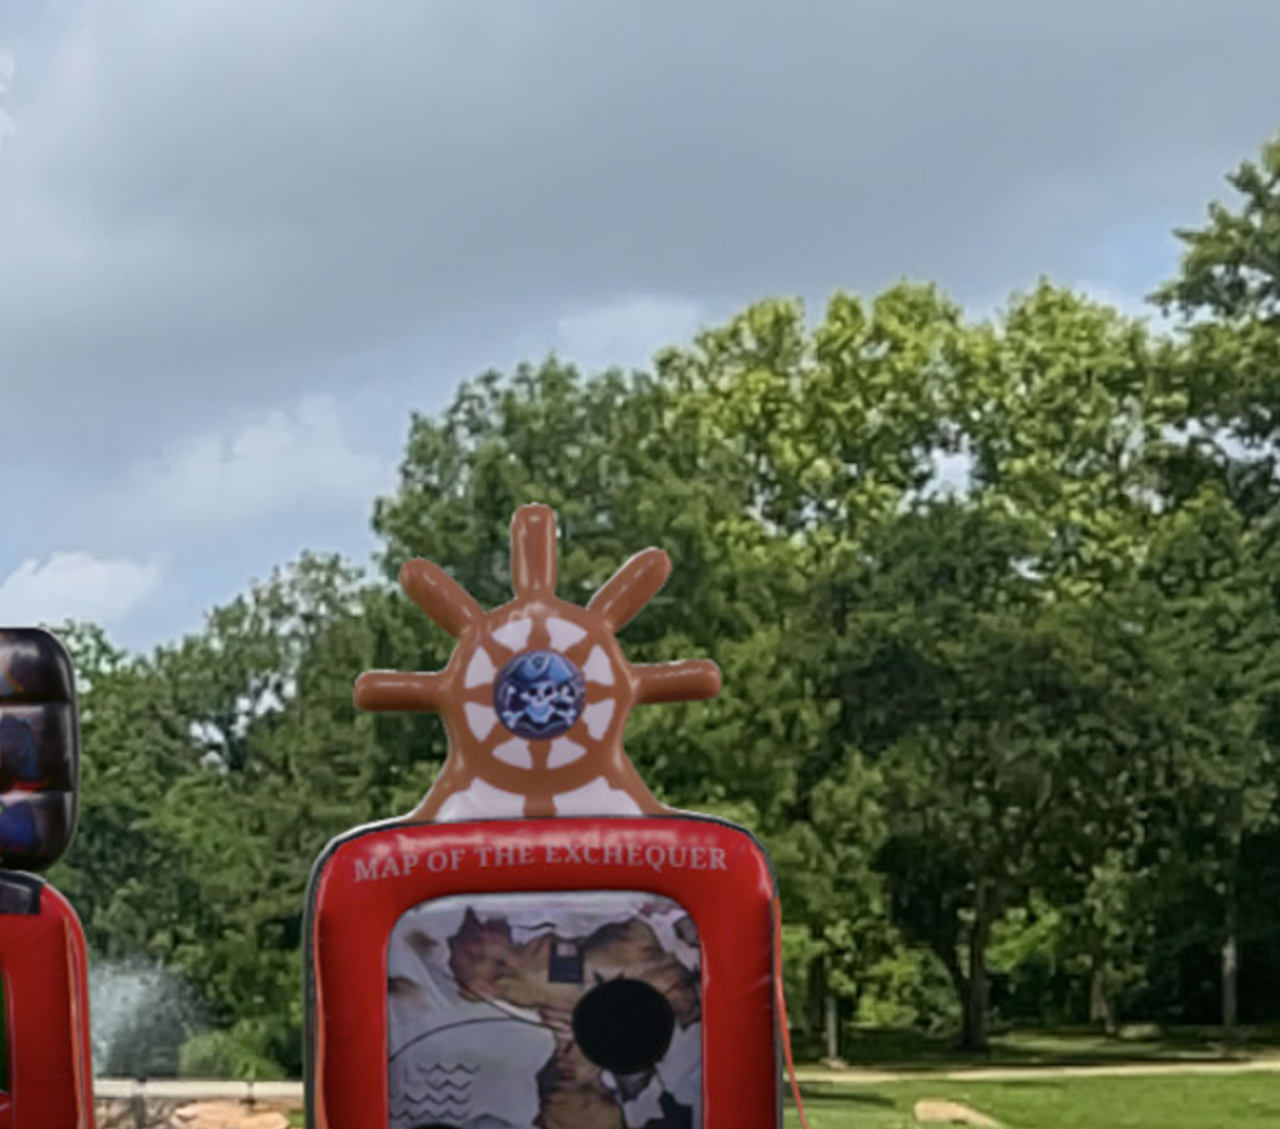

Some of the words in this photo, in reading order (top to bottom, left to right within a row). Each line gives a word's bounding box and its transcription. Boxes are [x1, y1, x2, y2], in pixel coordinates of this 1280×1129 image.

[353, 852, 419, 882] MAP
[426, 849, 466, 873] OF
[474, 844, 537, 868] THE
[544, 843, 729, 873] EXCHEQUER
